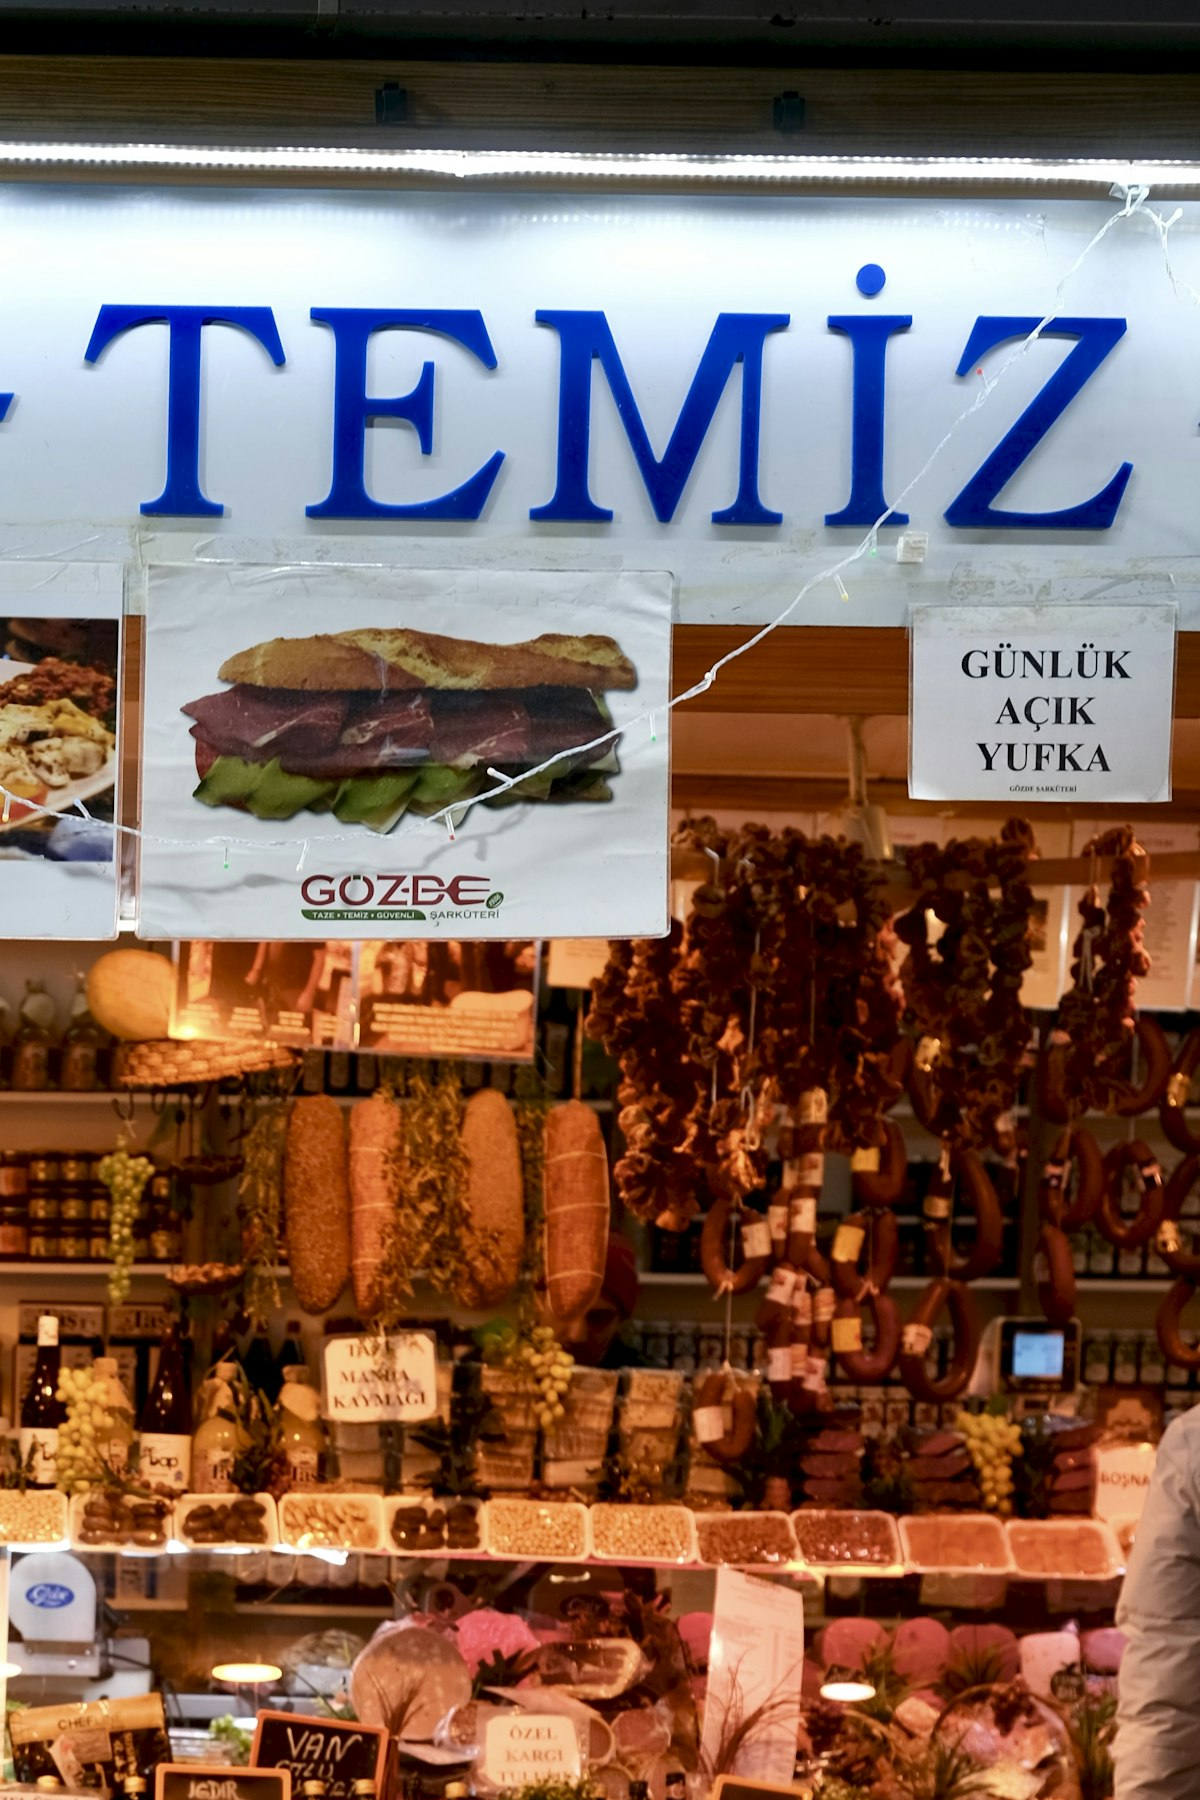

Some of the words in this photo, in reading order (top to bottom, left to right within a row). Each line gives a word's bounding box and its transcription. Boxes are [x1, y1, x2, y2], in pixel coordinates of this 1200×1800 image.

[84, 264, 1134, 528] TEMİZ
[961, 643, 1131, 679] GÜNLÜK
[995, 696, 1096, 732] AÇIK
[976, 743, 1112, 772] YUFKA
[1009, 784, 1034, 793] GÖZDE
[1035, 784, 1077, 793] ŞARKÜTERİ
[301, 874, 490, 906] GÖZDE
[313, 912, 335, 920] TAZE
[343, 911, 368, 920] TEMİZ
[376, 911, 415, 920] GÜVENLİ
[430, 909, 500, 921] ŞARKÜTERİ
[286, 1727, 363, 1763] VAN
